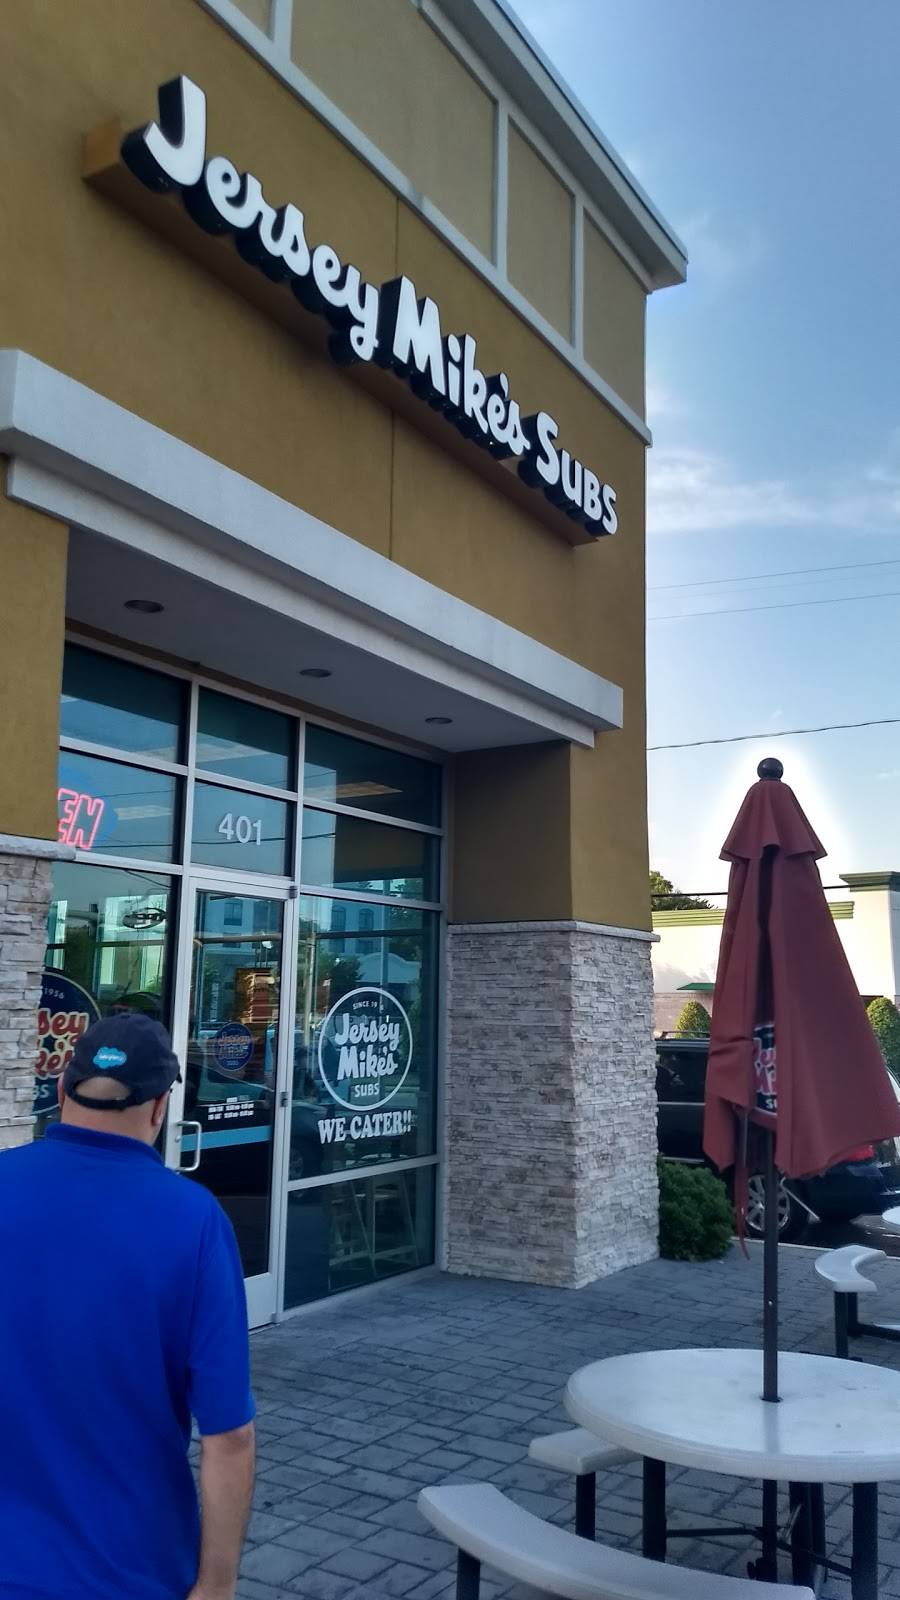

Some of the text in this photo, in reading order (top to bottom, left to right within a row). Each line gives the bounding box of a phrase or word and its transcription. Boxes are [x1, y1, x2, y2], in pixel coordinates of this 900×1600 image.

[142, 74, 618, 535] Jersey Mike's SUBS
[57, 787, 105, 850] EN
[218, 813, 262, 845] 401
[352, 1000, 370, 1011] SINCE
[38, 1009, 88, 1041] sey
[335, 1013, 400, 1051] Jersey
[337, 1044, 399, 1080] Mike's
[354, 1083, 380, 1098] SUBS
[317, 1109, 412, 1145] WE CATER!!
